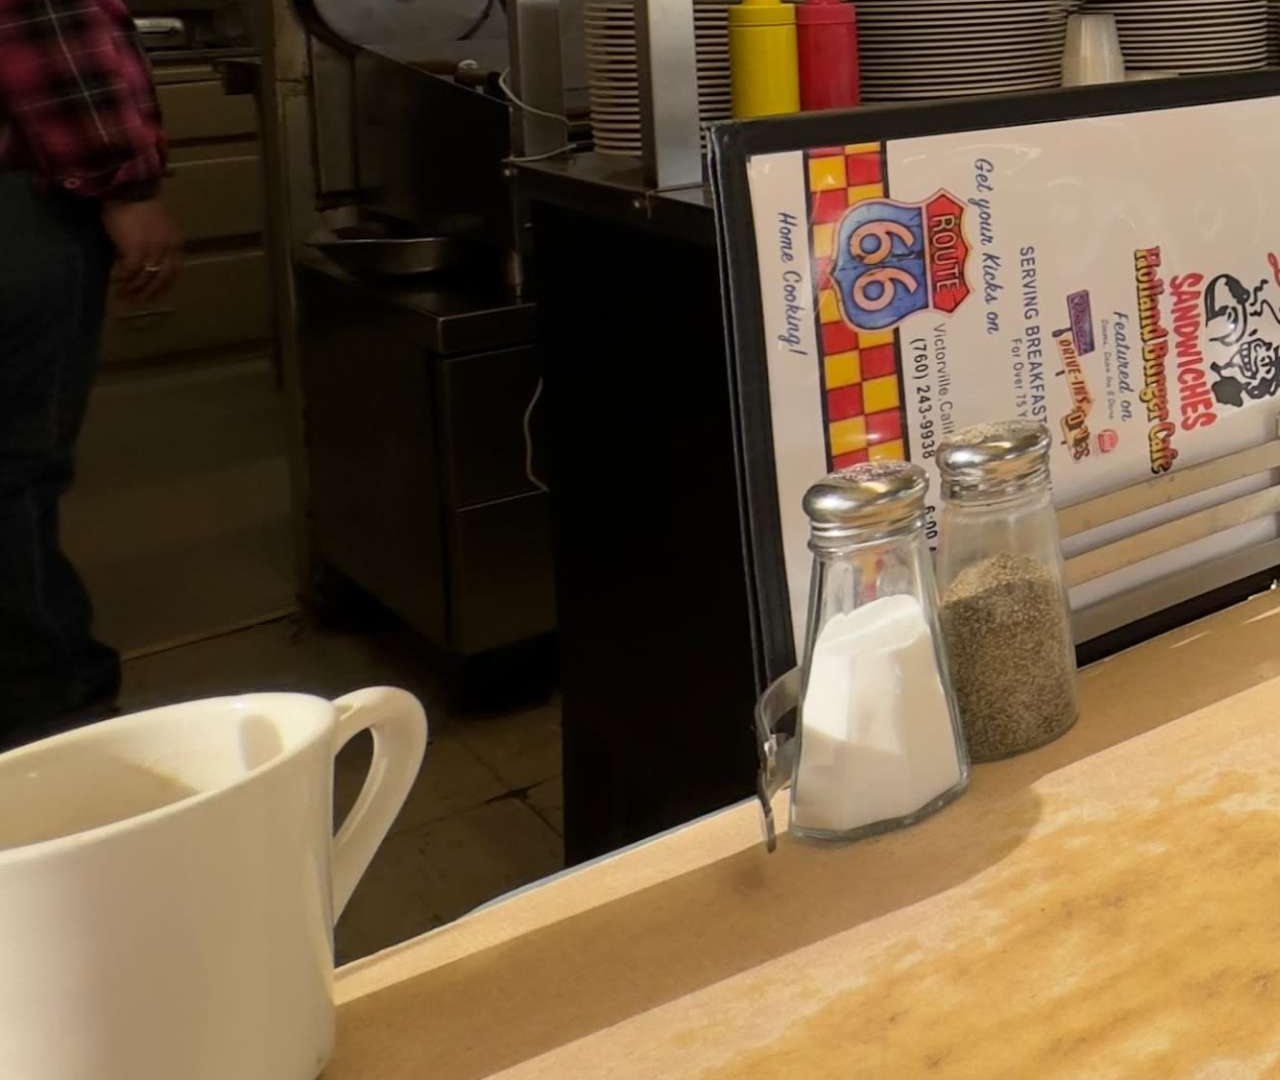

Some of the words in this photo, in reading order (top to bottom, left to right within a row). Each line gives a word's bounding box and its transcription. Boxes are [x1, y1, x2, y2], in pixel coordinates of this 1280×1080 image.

[974, 158, 994, 193] Get
[778, 211, 798, 264] Home
[931, 214, 961, 294] ROUTE
[967, 197, 994, 246] your
[849, 219, 918, 313] 66
[982, 252, 1004, 305] Kicks
[1020, 245, 1040, 320] SERVING
[1134, 245, 1168, 342] Holland
[777, 270, 808, 356] Cooking!
[986, 311, 1001, 335] on
[1011, 338, 1024, 357] For
[910, 336, 930, 383] (760)
[1012, 360, 1025, 391] Over
[1025, 325, 1048, 424] BREAKFAST
[1113, 310, 1134, 393] Featured
[1141, 340, 1169, 423] Burger
[1169, 272, 1217, 431] SANDWICHES
[916, 384, 936, 460] 243-9938
[1121, 400, 1133, 422] on
